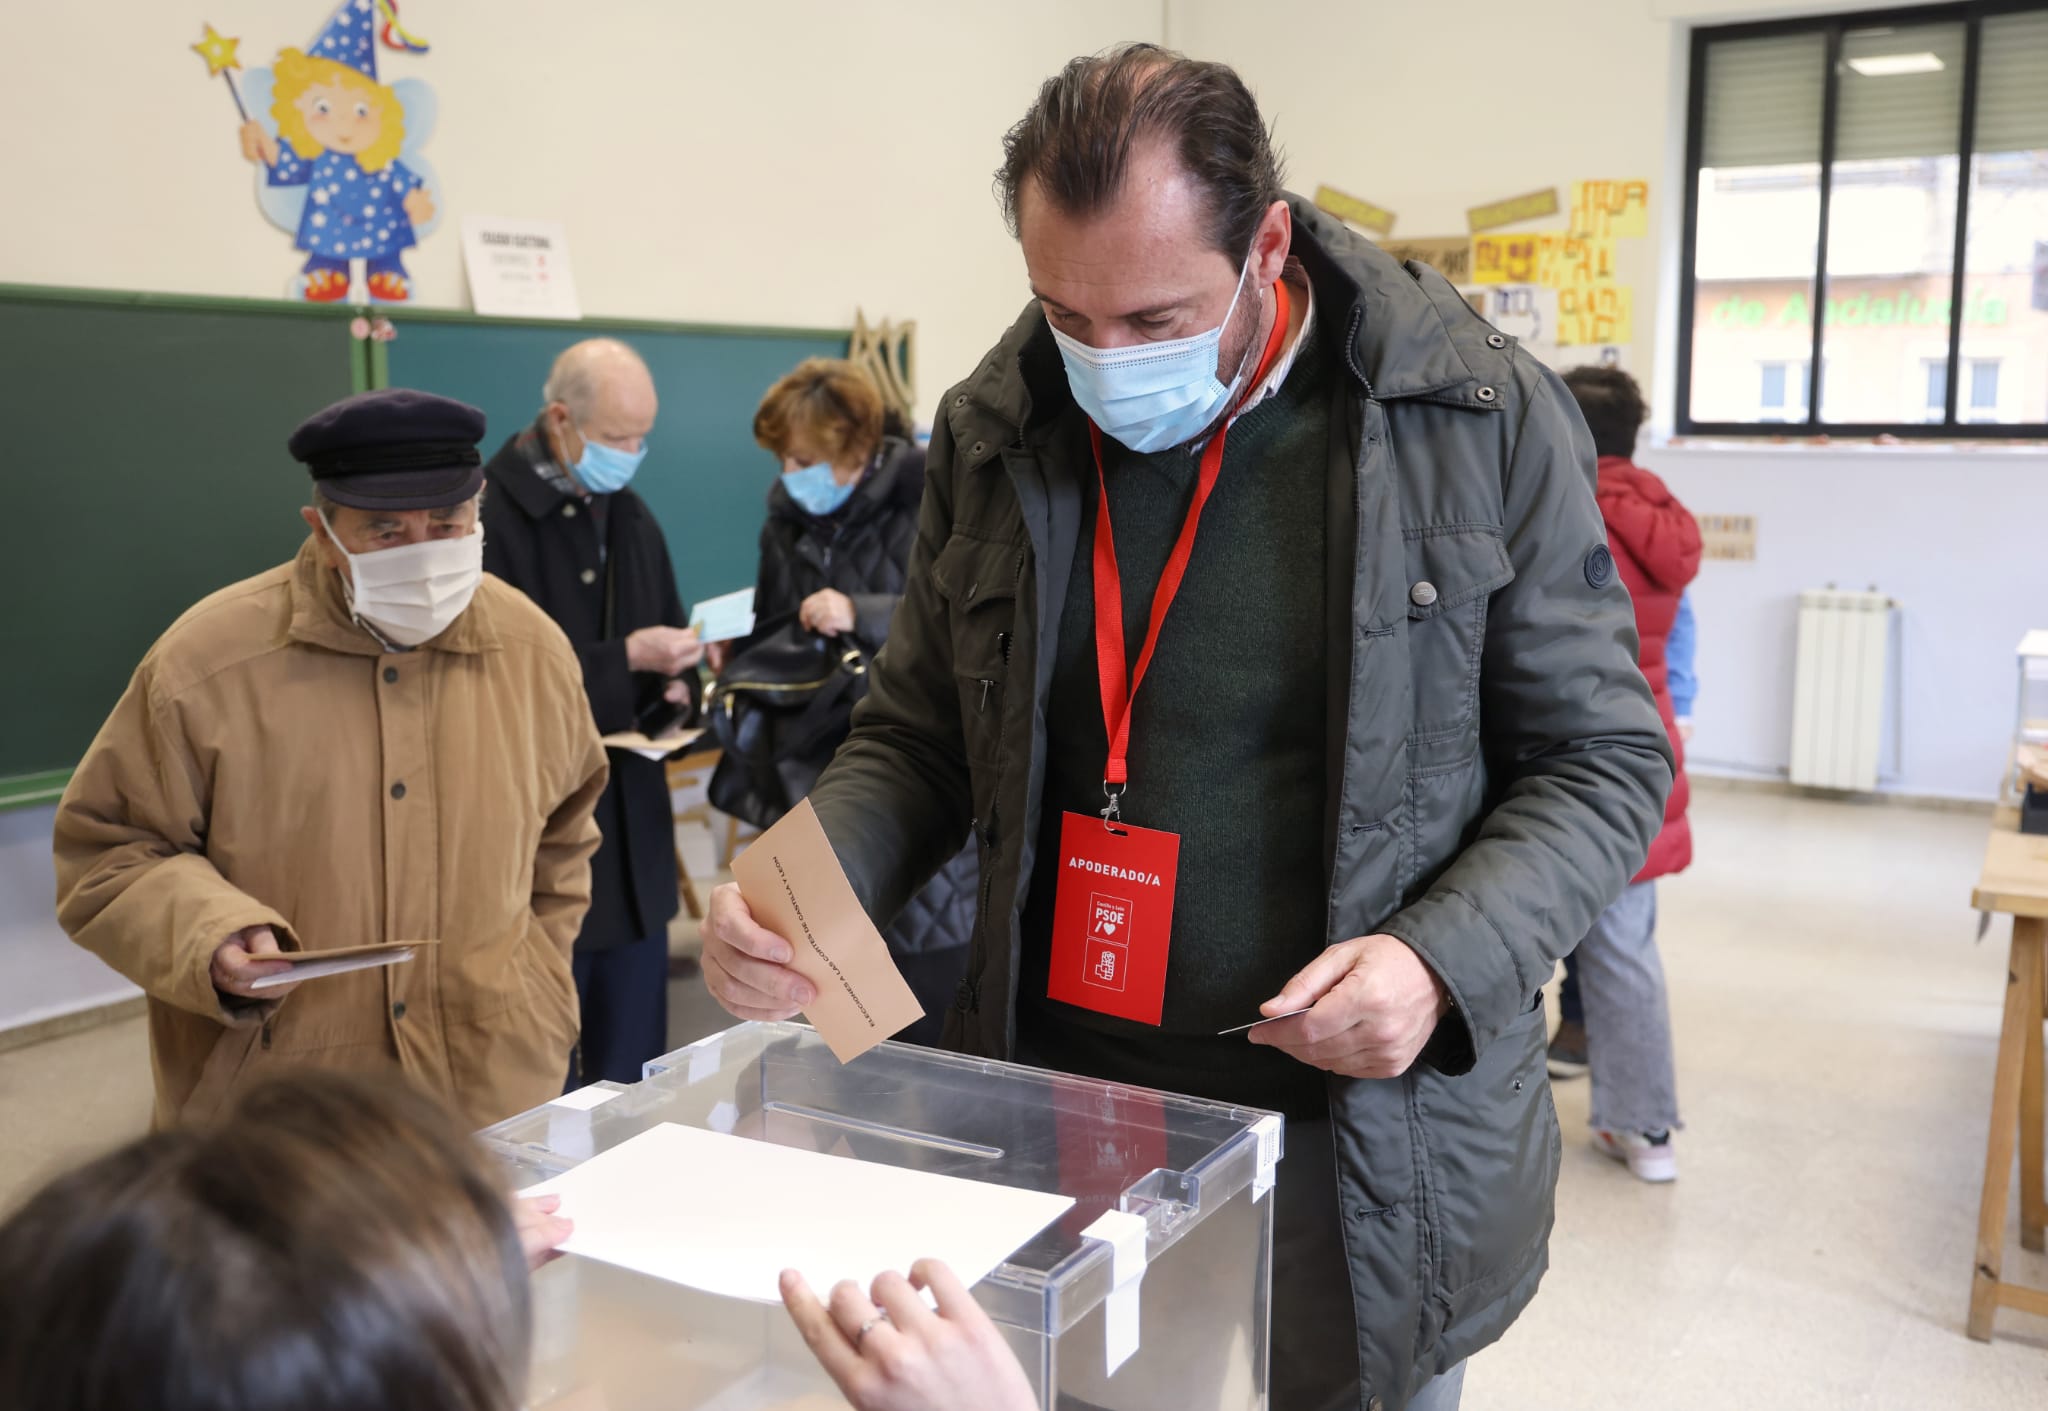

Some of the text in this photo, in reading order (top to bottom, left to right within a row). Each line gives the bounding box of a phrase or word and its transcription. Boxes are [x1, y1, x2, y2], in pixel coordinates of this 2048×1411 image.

[1711, 293, 1766, 327] de
[1068, 856, 1161, 887] APODERADO/A
[785, 884, 804, 921] CASTILLA
[1095, 907, 1125, 925] PSOE
[801, 921, 809, 933] DE
[807, 933, 829, 962] CORTES
[828, 961, 841, 976] LAS
[843, 981, 876, 1028] ELECCIONES
